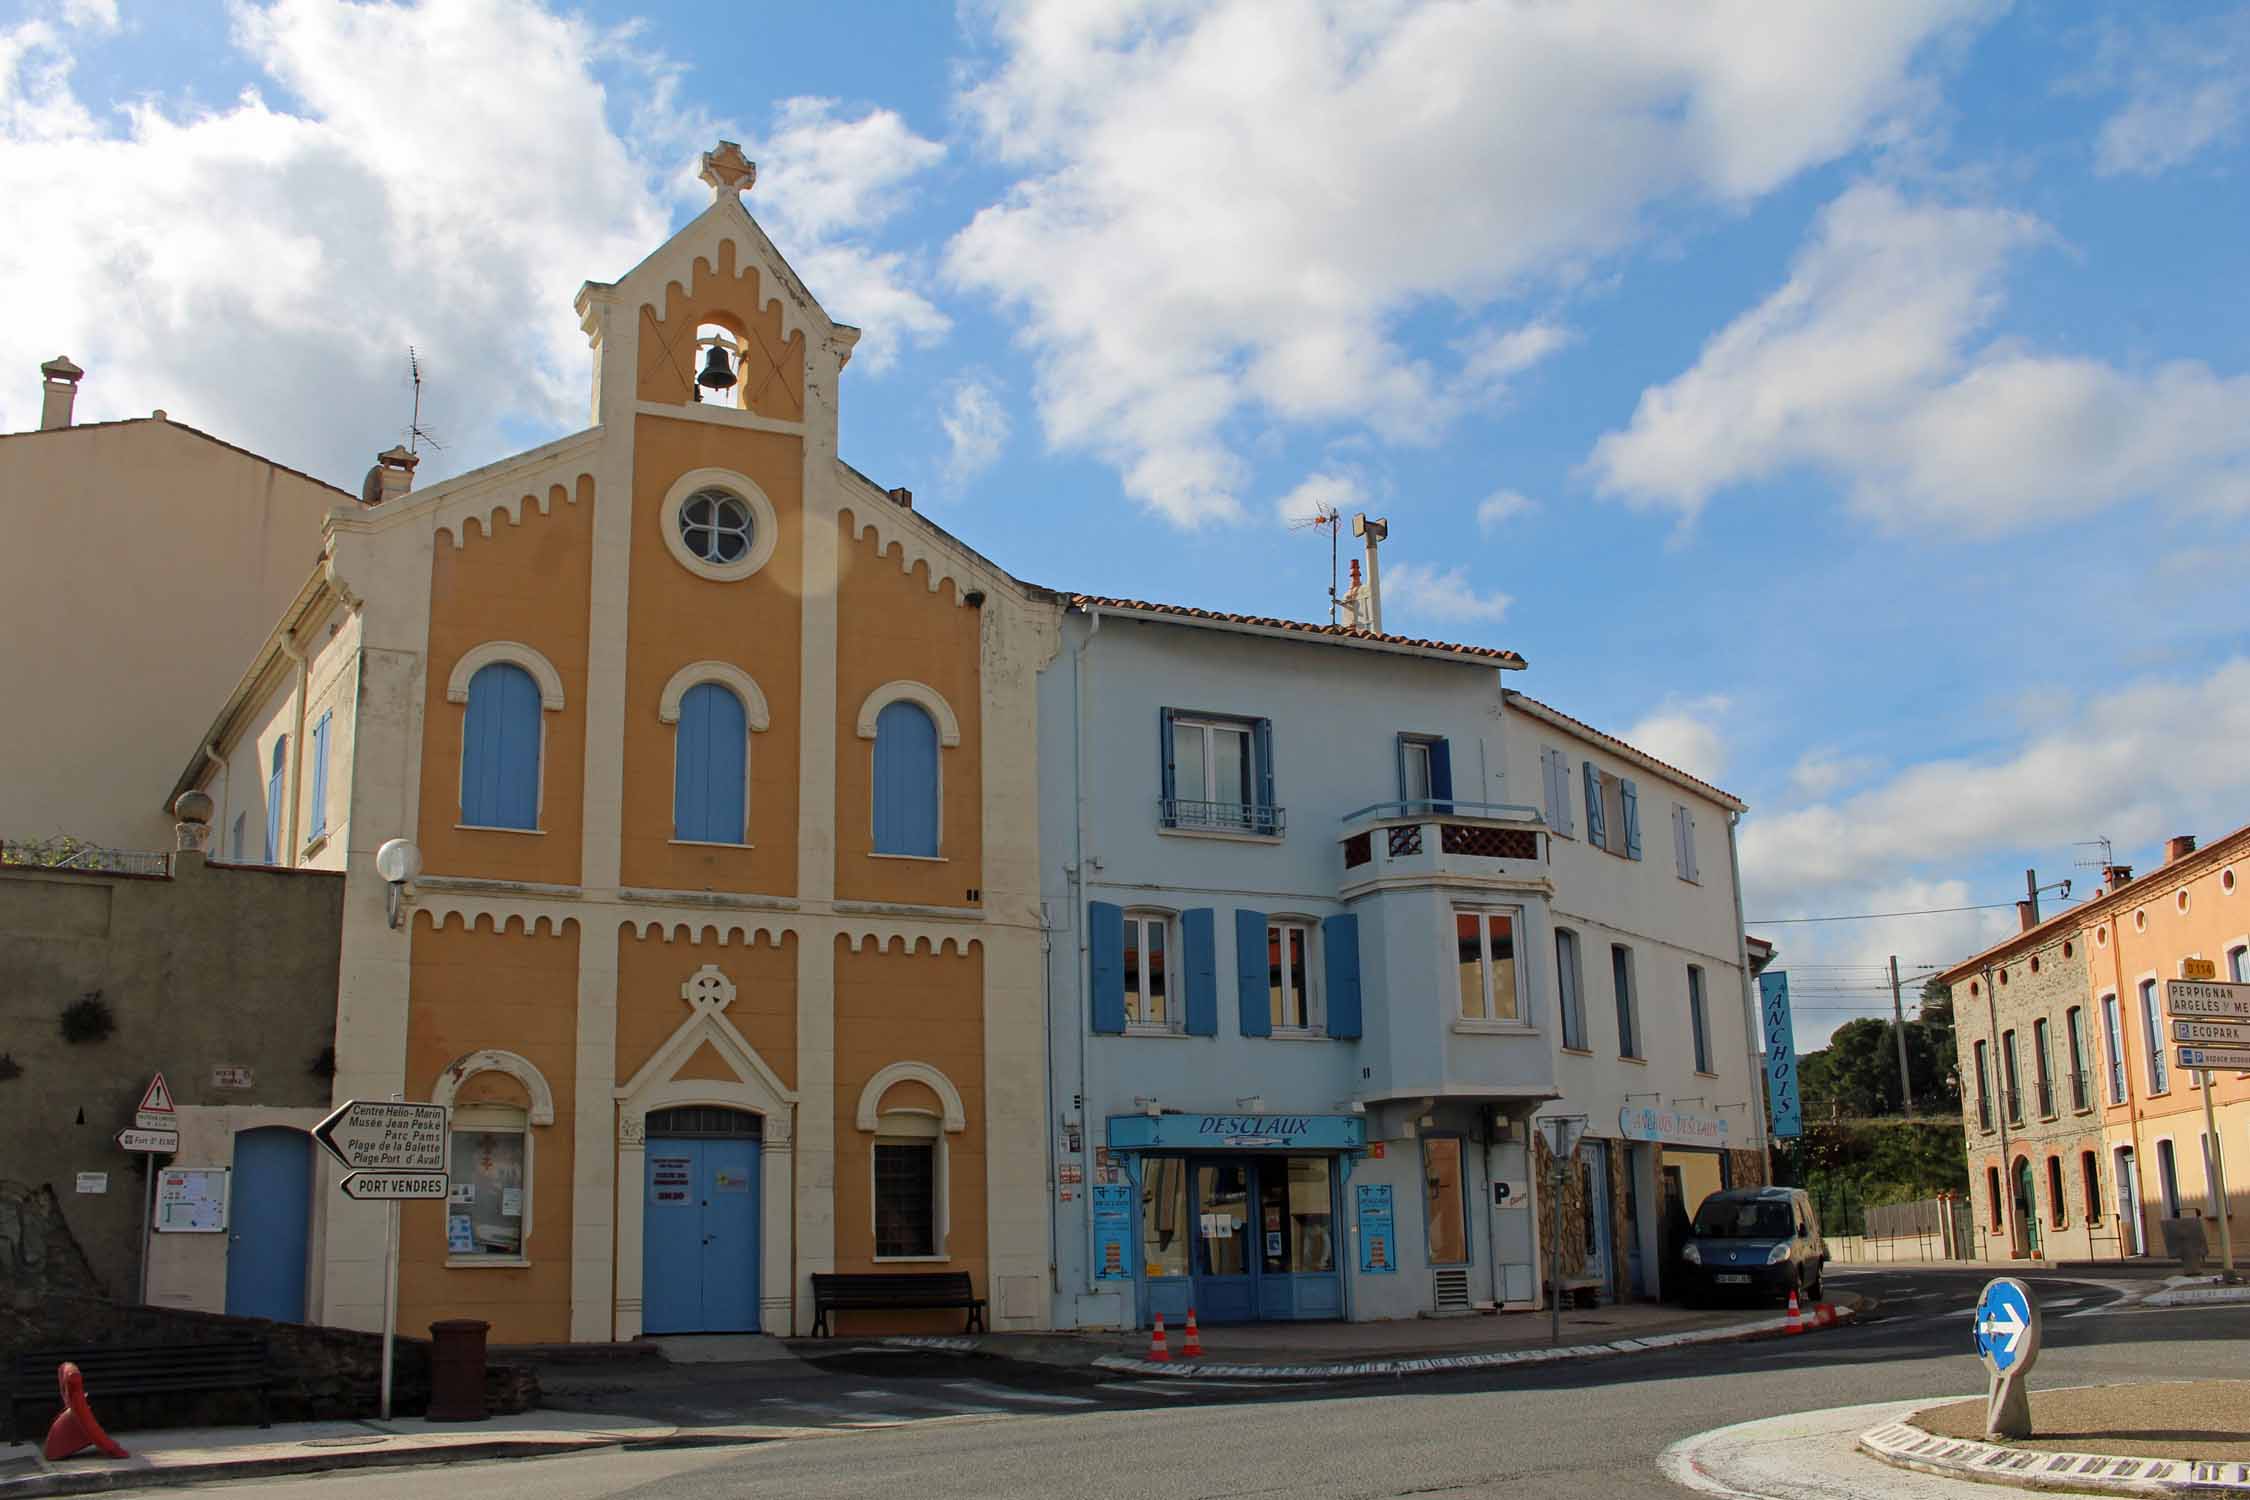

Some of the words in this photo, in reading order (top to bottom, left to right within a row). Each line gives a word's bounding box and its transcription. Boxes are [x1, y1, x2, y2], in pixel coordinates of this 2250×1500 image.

[2172, 985, 2233, 999] PERPIGNAN
[2192, 1026, 2239, 1040] ECOPARK
[1768, 993, 1793, 1114] ANCHOIS
[353, 1104, 384, 1117] Centre
[385, 1118, 409, 1129] Jean
[1199, 1116, 1311, 1137] DESCLAUX
[384, 1130, 408, 1140] Parc
[412, 1131, 440, 1142] Pams
[348, 1139, 376, 1152] Plage
[379, 1141, 391, 1151] de
[393, 1141, 402, 1151] la
[405, 1142, 440, 1153] Balette
[353, 1152, 379, 1165] Plage
[380, 1153, 401, 1164] Port
[359, 1180, 386, 1193] PORT
[391, 1180, 441, 1193] VENDRES
